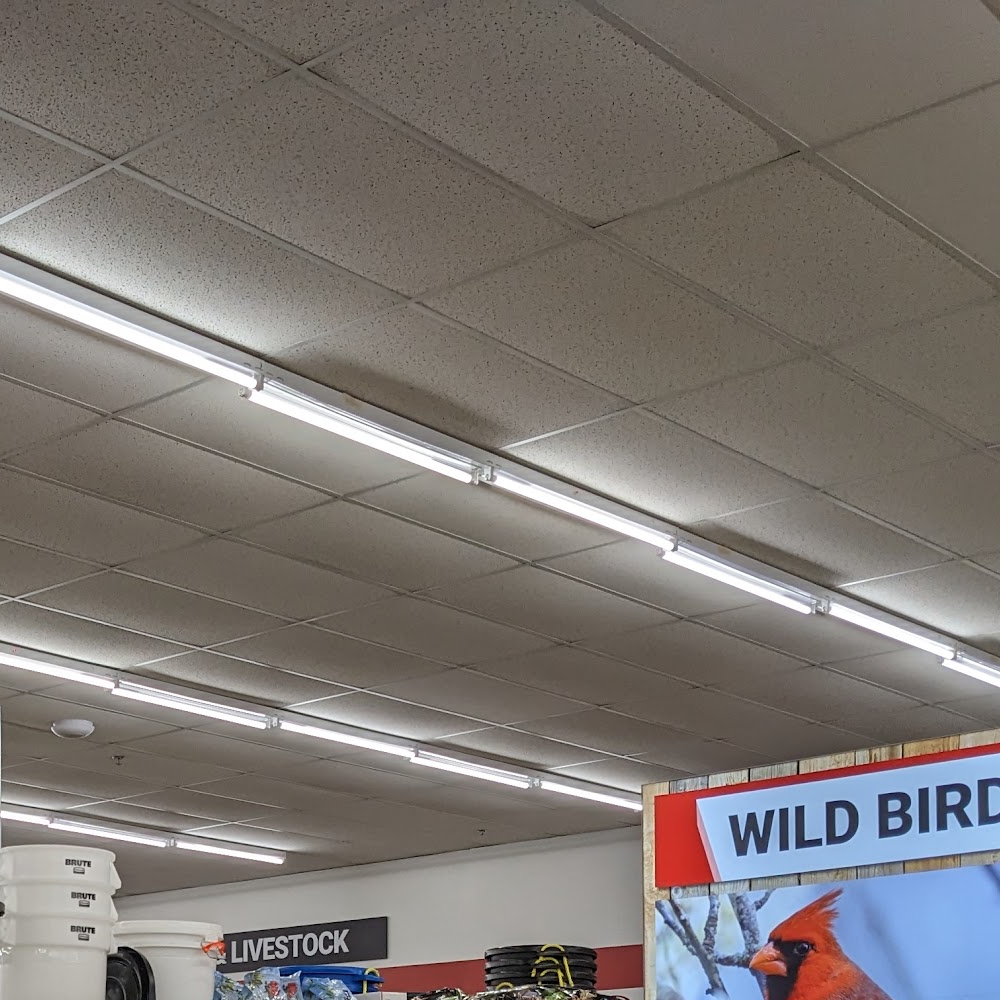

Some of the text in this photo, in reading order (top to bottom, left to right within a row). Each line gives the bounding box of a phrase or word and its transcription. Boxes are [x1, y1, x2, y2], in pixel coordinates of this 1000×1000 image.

[729, 777, 1000, 857] WILD BIRD
[65, 858, 92, 868] BRUTE
[71, 891, 96, 901] BRUTE
[70, 925, 96, 935] BRUTE
[231, 929, 350, 963] LIVESTOCK
